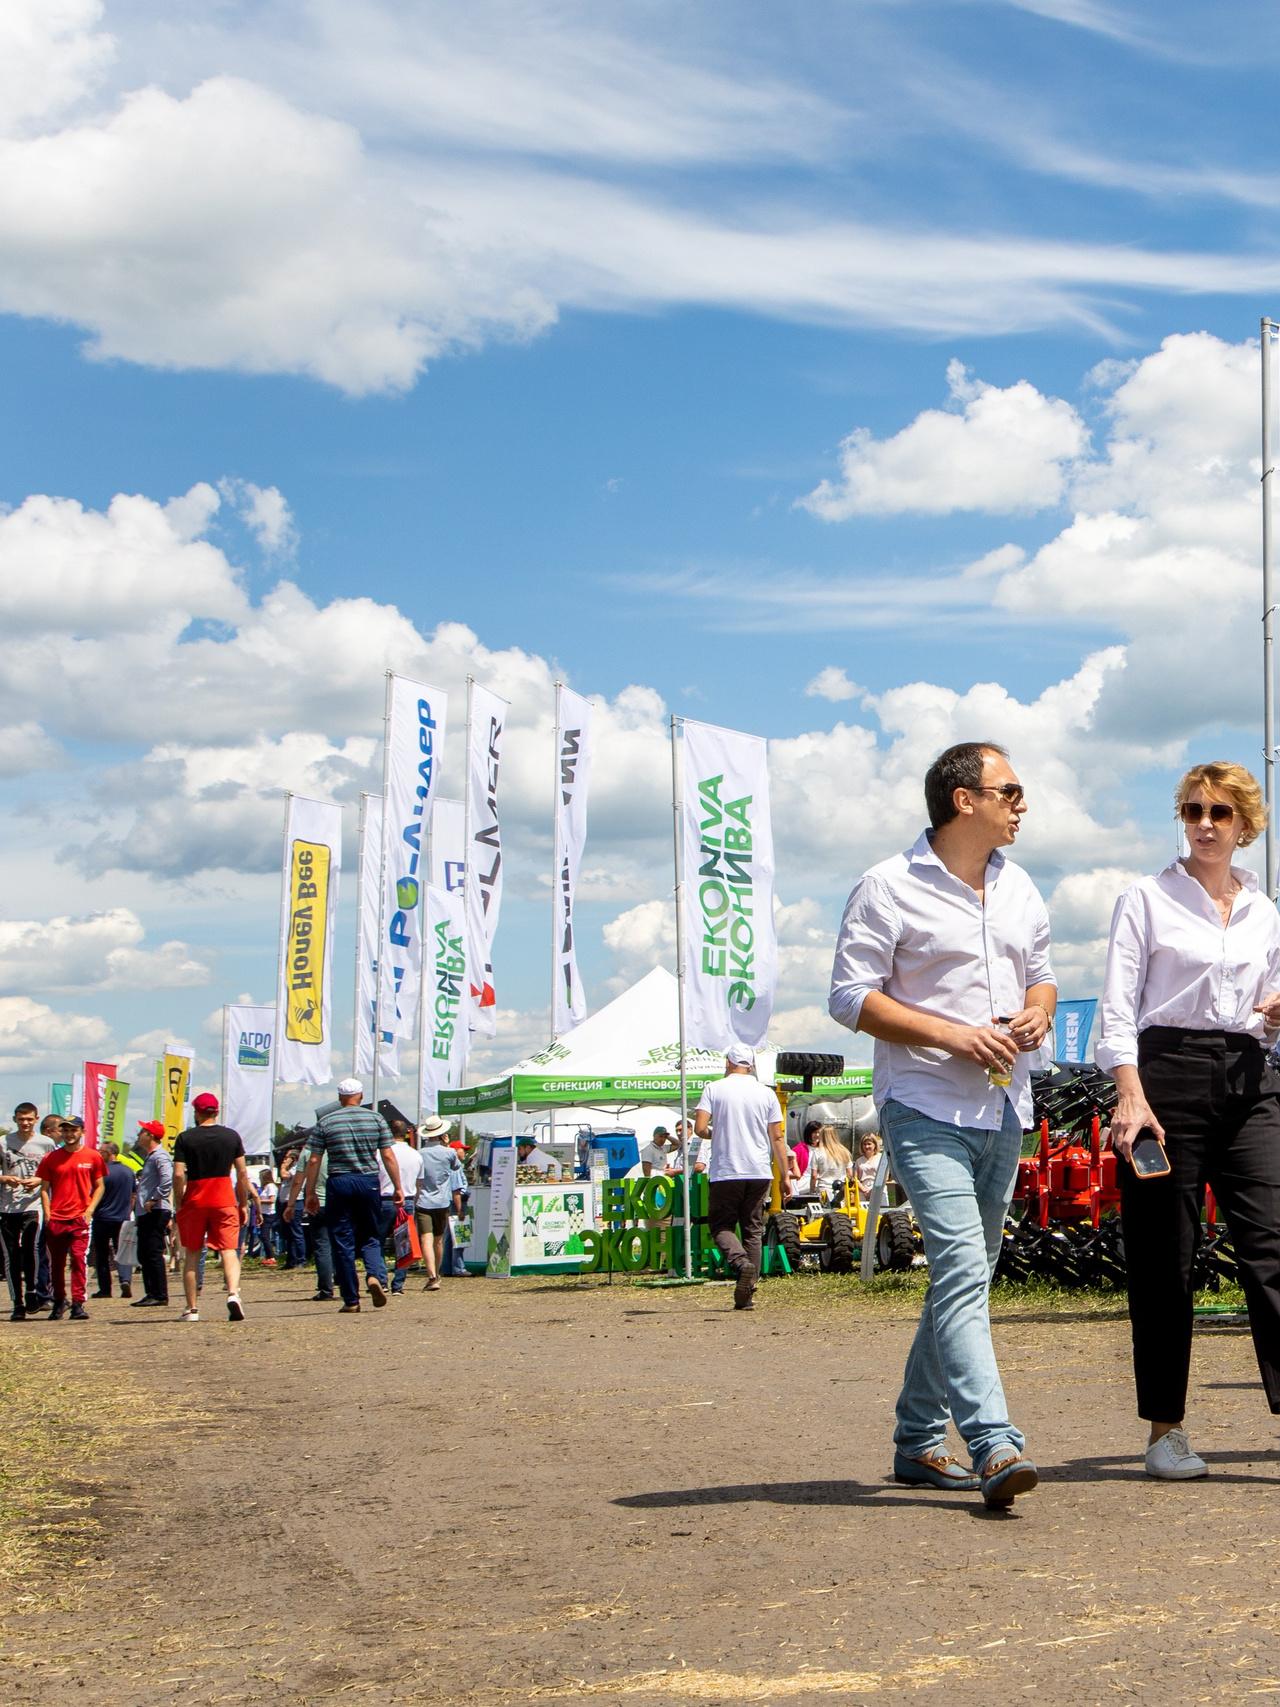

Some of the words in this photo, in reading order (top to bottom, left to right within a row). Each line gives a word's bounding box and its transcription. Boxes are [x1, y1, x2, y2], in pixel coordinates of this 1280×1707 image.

[698, 773, 730, 978] EKONIVA
[724, 794, 757, 1012] ЭКОНИВА
[240, 1031, 272, 1050] АГРО
[432, 919, 451, 1061] EKONIVA
[542, 1080, 603, 1092] СЕЛЕКЦИЯ
